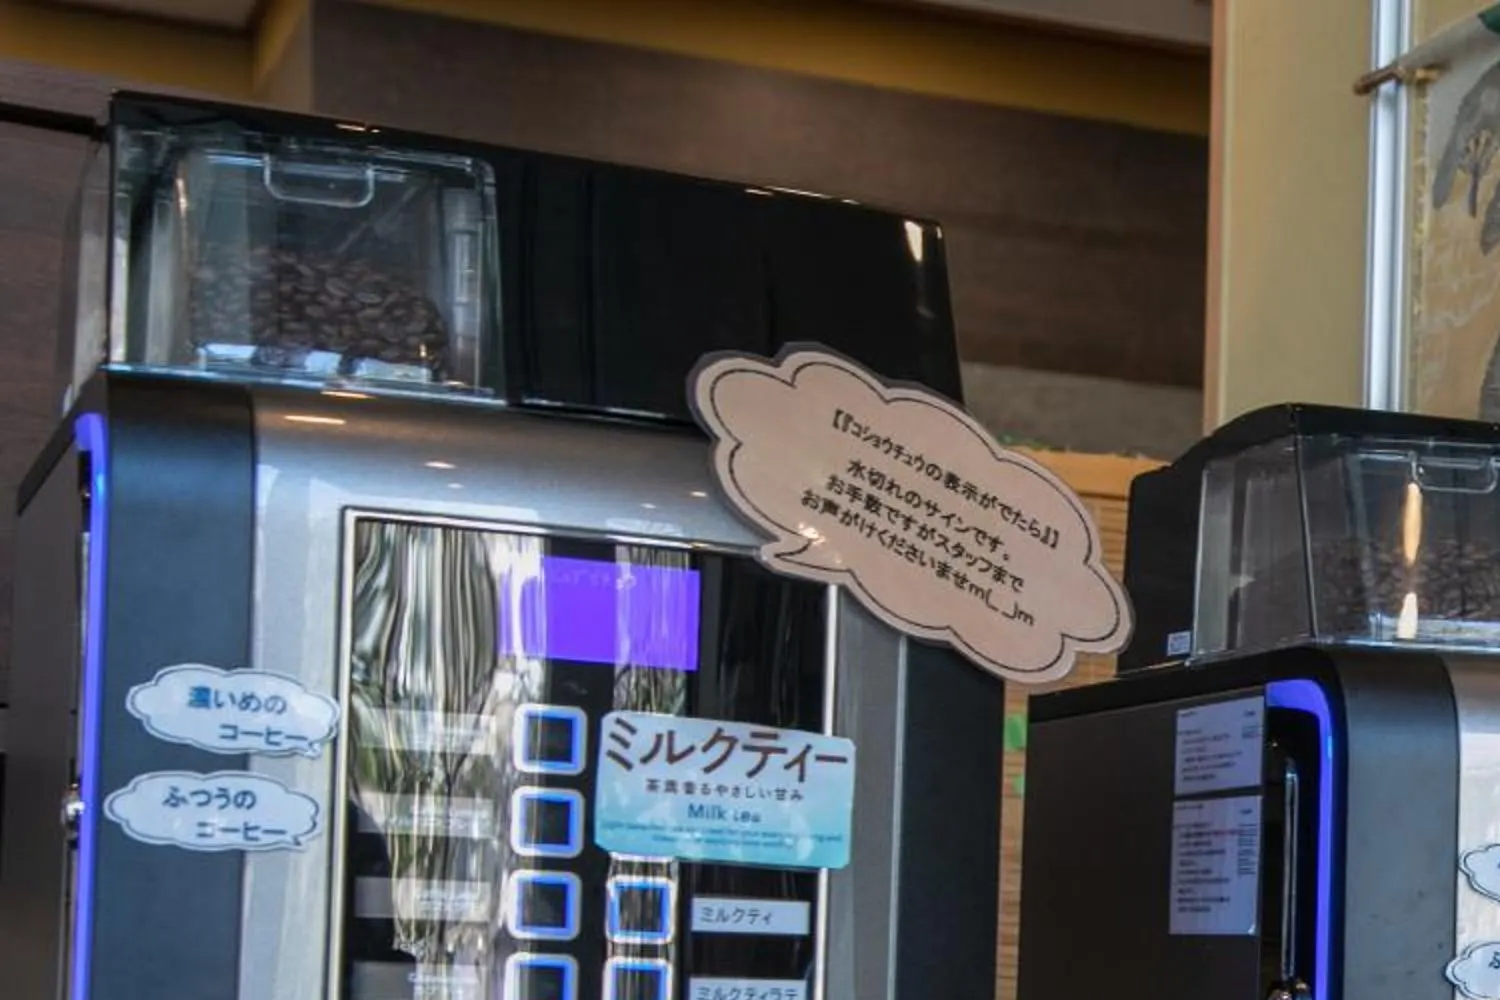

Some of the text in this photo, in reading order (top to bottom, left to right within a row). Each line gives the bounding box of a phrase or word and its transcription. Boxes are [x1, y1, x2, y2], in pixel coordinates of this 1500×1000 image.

[846, 458, 1011, 561] 水切れのサインです。
[826, 474, 1025, 593] お手数ですがスタッフまで
[218, 724, 308, 747] コーヒー
[606, 717, 848, 783] ミルクティー
[162, 786, 257, 811] ふつうの
[687, 803, 727, 819] Milk
[196, 821, 288, 842] コーヒー
